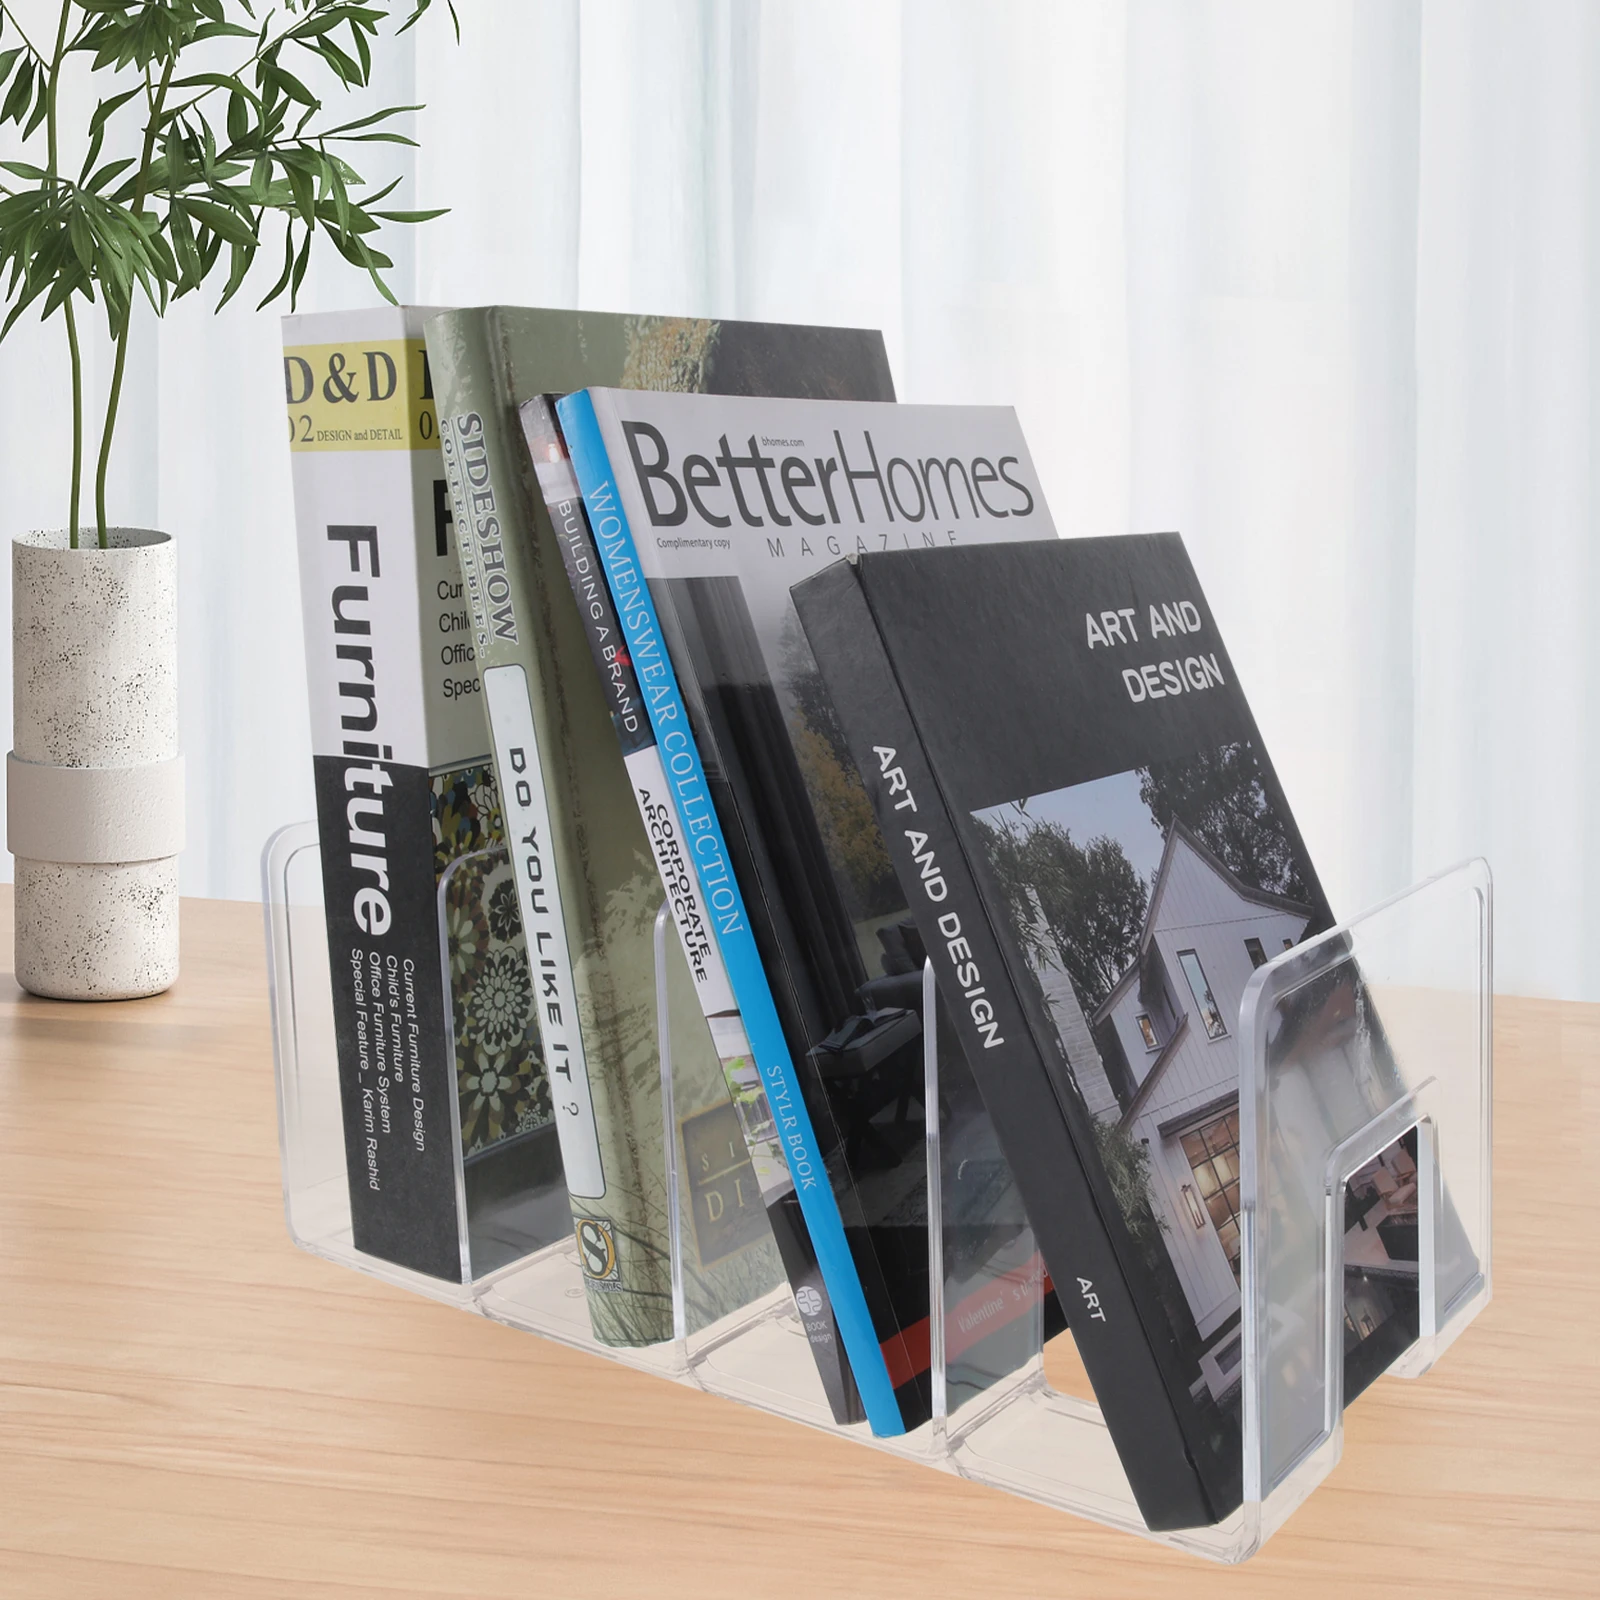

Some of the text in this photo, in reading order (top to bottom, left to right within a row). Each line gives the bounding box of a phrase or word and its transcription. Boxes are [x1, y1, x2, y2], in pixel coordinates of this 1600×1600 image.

[317, 429, 352, 442] DESIGN
[354, 429, 368, 441] and
[370, 428, 403, 441] DETAIL
[761, 436, 805, 447] bhomes.com
[440, 418, 489, 646] COLLECTIBLES
[457, 411, 519, 645] SIDESHOW
[656, 537, 731, 550] Complimentary copy
[438, 610, 471, 633] Chil
[558, 500, 639, 733] BUILDING A BRAND
[1086, 600, 1202, 650] ART AND
[1121, 652, 1226, 703] DESIGN
[326, 524, 394, 936] Furniture
[589, 480, 745, 936] WOMENSWEAR COLLECTION
[509, 747, 532, 808] DO
[521, 825, 550, 914] YOU
[536, 931, 564, 1026] LIKE
[552, 1043, 573, 1083] IT
[638, 787, 709, 984] ARCHITECTURE
[656, 803, 712, 958] CORPORATE
[872, 744, 1005, 1049] ART AND DESIGN
[350, 948, 367, 1007] Special
[356, 1010, 369, 1071] Feature
[385, 954, 404, 1083] Child's Furniture
[368, 951, 391, 1134] Office Furniture System
[402, 957, 425, 1152] Current Furniture Design
[362, 1088, 375, 1133] Karim
[366, 1136, 381, 1191] Rashid
[766, 1065, 817, 1192] STYLR BOOK
[1076, 1276, 1107, 1322] ART
